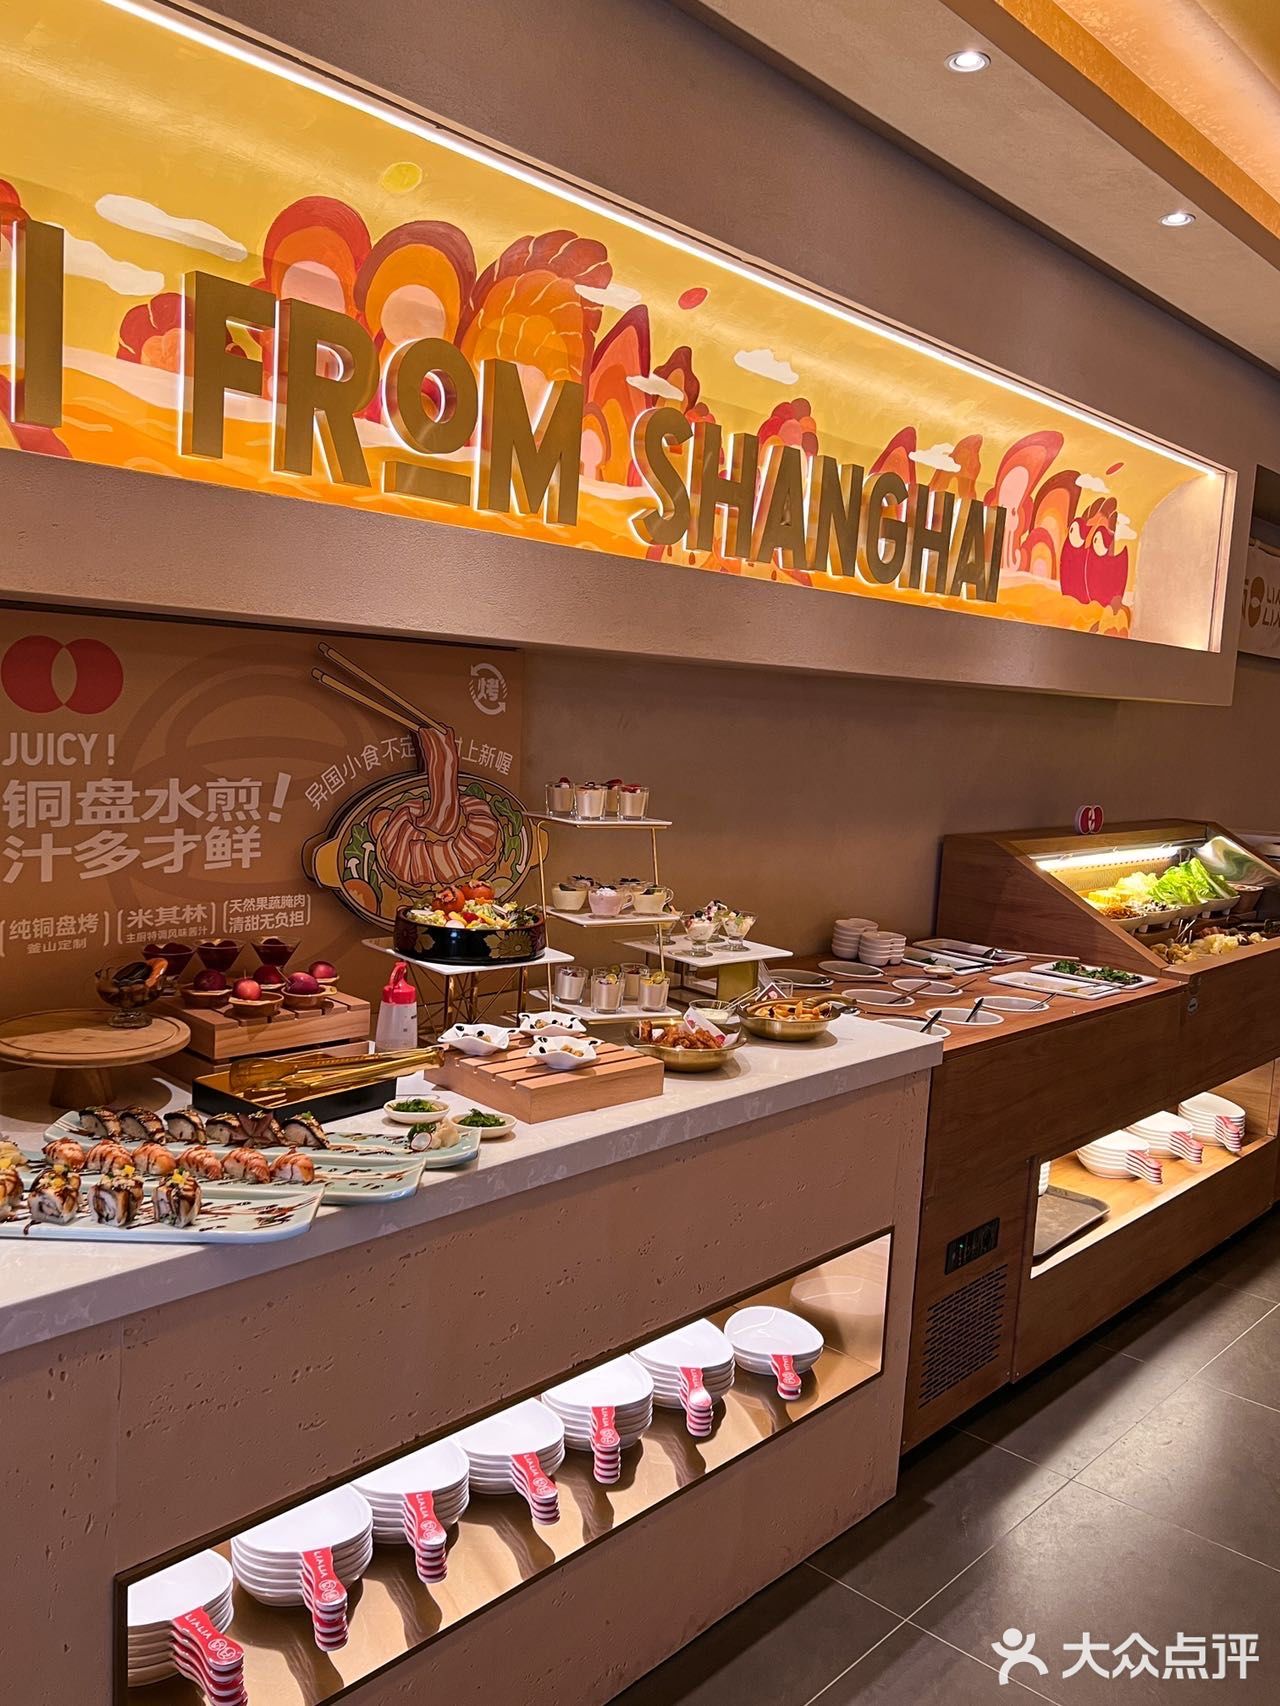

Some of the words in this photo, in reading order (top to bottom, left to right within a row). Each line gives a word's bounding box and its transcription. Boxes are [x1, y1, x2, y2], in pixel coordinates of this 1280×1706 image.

[180, 270, 583, 527] FROM
[631, 407, 1007, 603] SHANGHAI
[477, 677, 500, 702] 烤
[2, 732, 116, 766] JUICY!
[1, 771, 293, 829] 铜盘水煎！
[2, 825, 263, 884] 汁多才鲜
[126, 904, 208, 929] 米其林
[229, 894, 306, 914] 天然果蔬腌肉
[8, 912, 100, 941] 纯铜盘烤
[228, 911, 306, 933] 清甜无负担
[26, 937, 88, 954] 釜山定制
